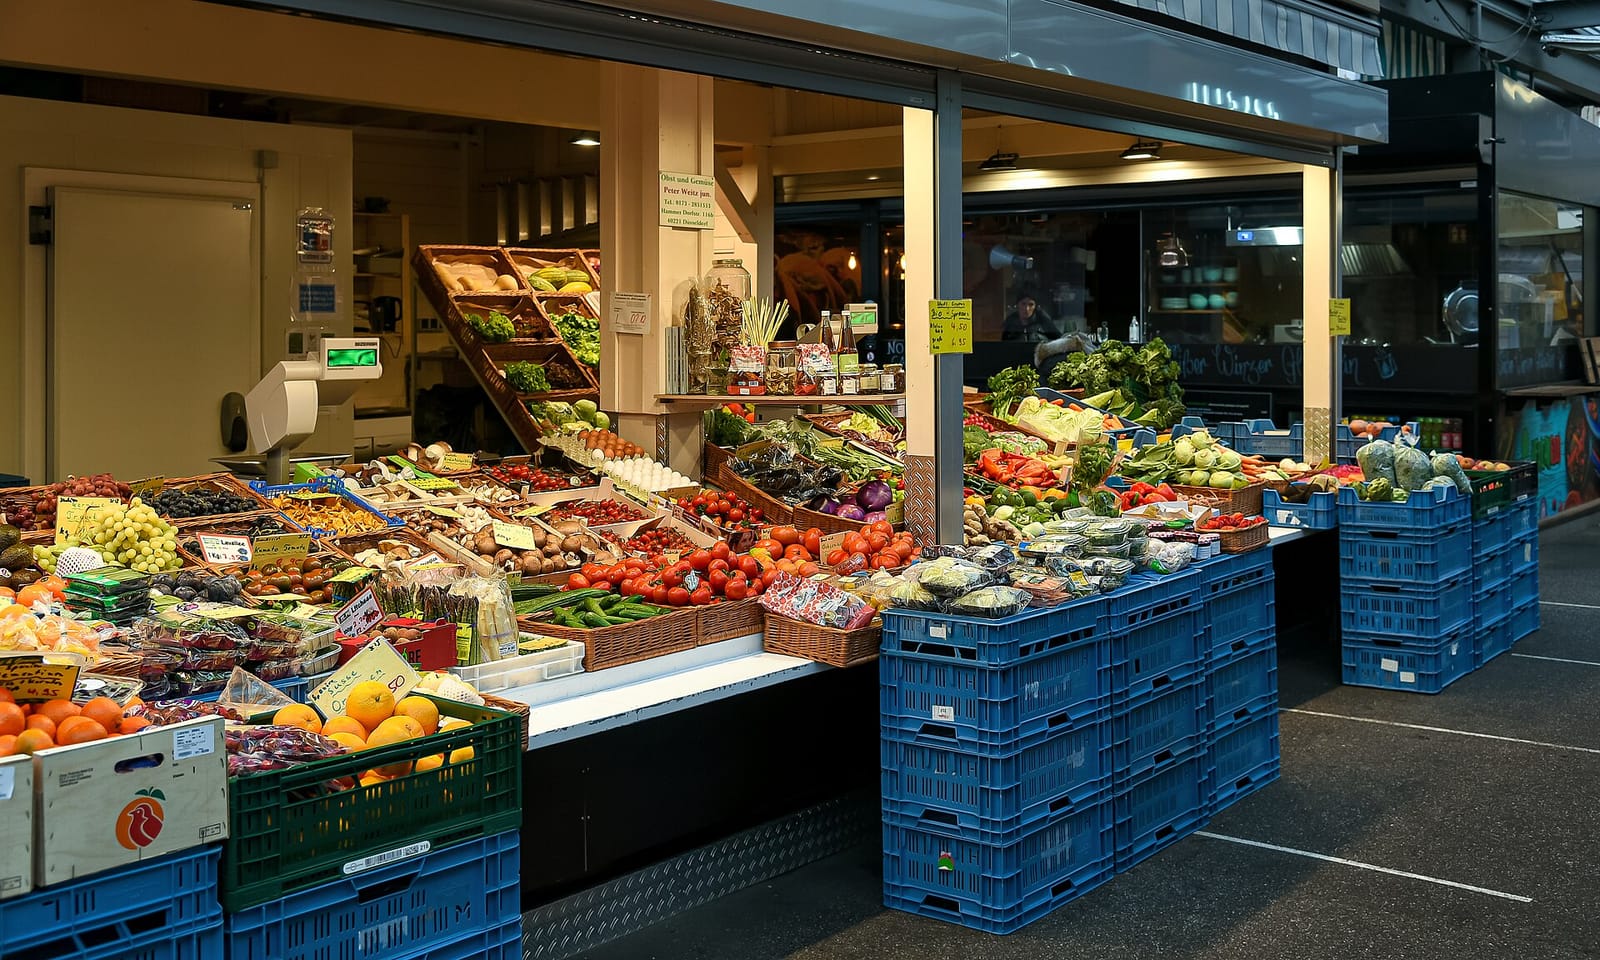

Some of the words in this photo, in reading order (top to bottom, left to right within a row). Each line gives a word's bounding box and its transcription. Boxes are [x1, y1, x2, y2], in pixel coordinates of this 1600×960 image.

[661, 174, 675, 182] Obst
[690, 177, 714, 187] Gemüse
[664, 186, 680, 195] Peter
[681, 188, 699, 197] Weitz
[700, 190, 711, 198] jun.
[1211, 344, 1273, 384] Winzer
